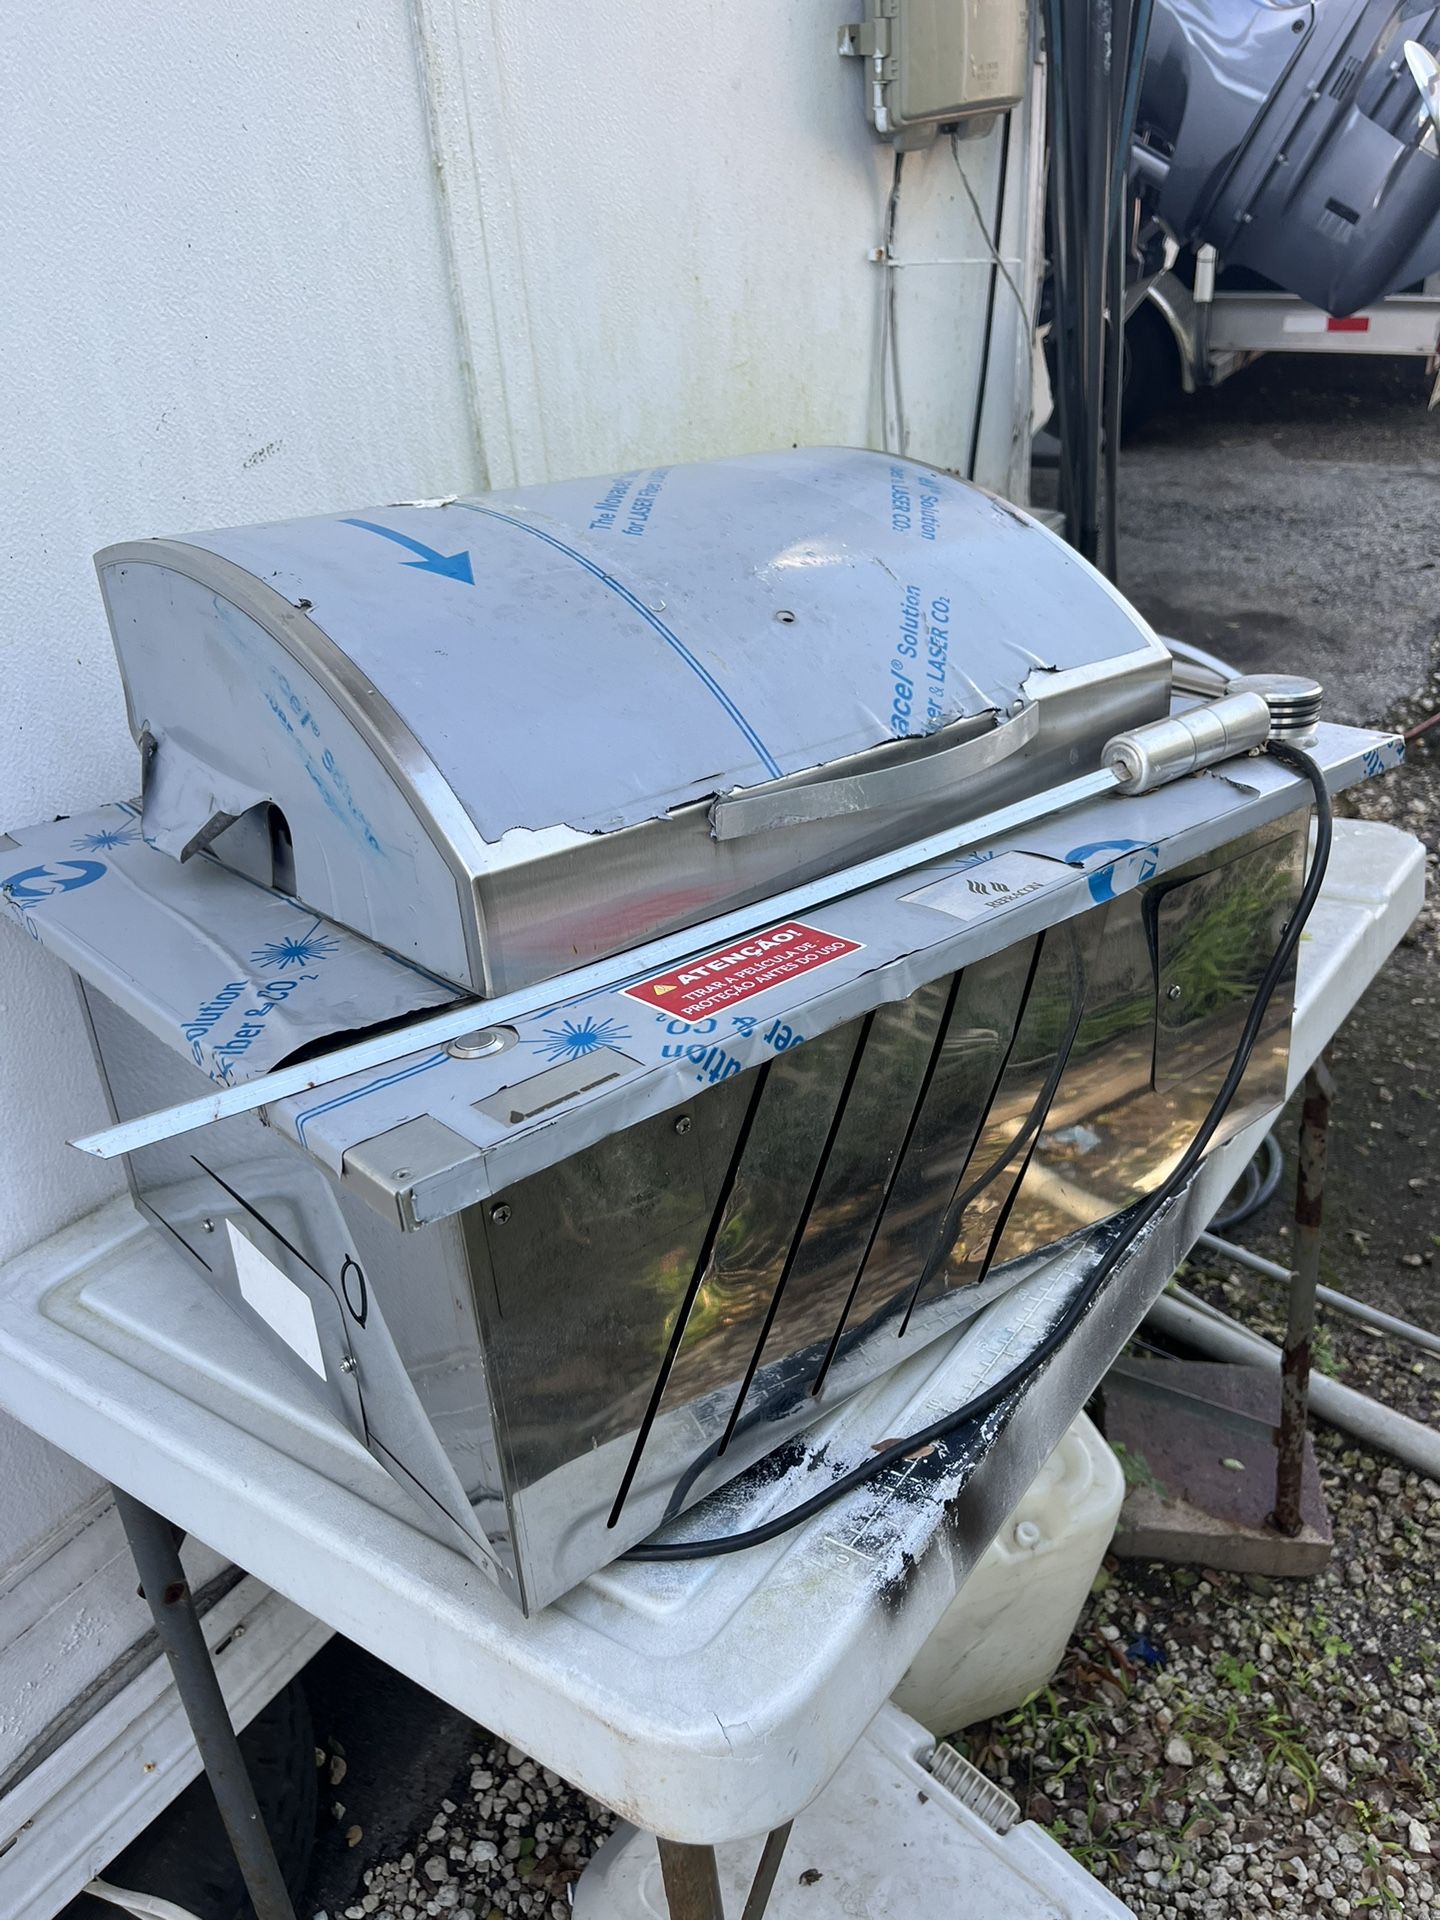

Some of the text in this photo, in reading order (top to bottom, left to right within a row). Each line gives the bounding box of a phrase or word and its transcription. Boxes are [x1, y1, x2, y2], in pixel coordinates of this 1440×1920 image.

[626, 497, 656, 521] LASER
[891, 484, 911, 512] LASER
[920, 494, 941, 540] Solution
[589, 515, 617, 530] The
[621, 521, 646, 536] for
[897, 584, 921, 659] Solution
[926, 627, 949, 684] LASER
[677, 928, 803, 986] ATENÇÃO!
[681, 941, 817, 1001] TIRAR A PELÍCULA DE
[681, 941, 846, 1016] PROTEÇÃO ANTES DO USO
[730, 1016, 758, 1038] &
